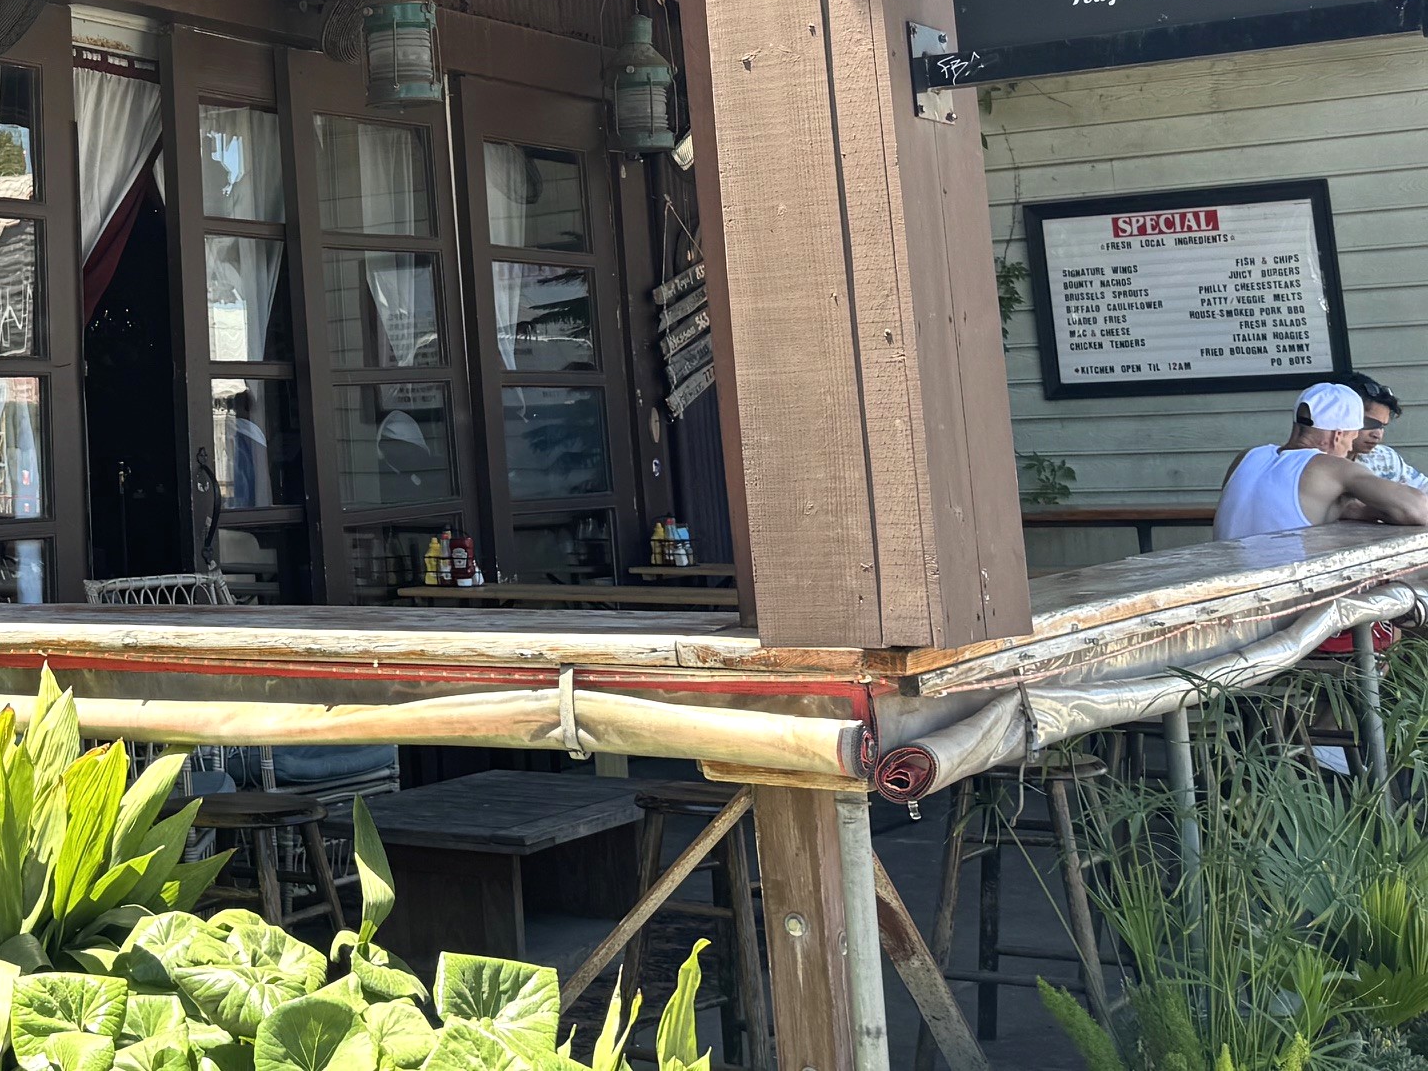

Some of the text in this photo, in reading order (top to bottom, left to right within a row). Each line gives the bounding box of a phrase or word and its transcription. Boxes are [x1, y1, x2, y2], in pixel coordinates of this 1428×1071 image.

[1117, 211, 1213, 236] SPECIAL
[1107, 234, 1228, 250] FRESH LOCAL INGREDIENTS
[1235, 254, 1300, 267] FISH & CHIPS
[1062, 265, 1138, 277] SIGNATURE WINGS
[1228, 267, 1300, 279] JUICY BURGERS
[1063, 277, 1132, 290] BOUNTY NACHOS
[1198, 279, 1301, 294] PHILLY CHEESESTEAKS
[1064, 289, 1149, 302] BRUSSELS SPROUTS
[1273, 292, 1302, 302] MELTS
[1107, 300, 1163, 311] CAULIFLOWER
[1259, 306, 1282, 316] PORK
[1287, 305, 1305, 314] BBQ
[1103, 315, 1127, 324] FRIES
[1239, 317, 1307, 329] FRESH SALADS
[1100, 327, 1131, 337] CHEESE
[1232, 330, 1310, 342] ITALIAN HOAGIES
[1069, 338, 1146, 351] CHICKEN TENDERS
[1200, 343, 1310, 357] FRIED BOLOGNA SAMMY
[1270, 355, 1312, 366] PO BOYS
[1080, 362, 1192, 375] KITCHEN OPEN TIL 12AM
